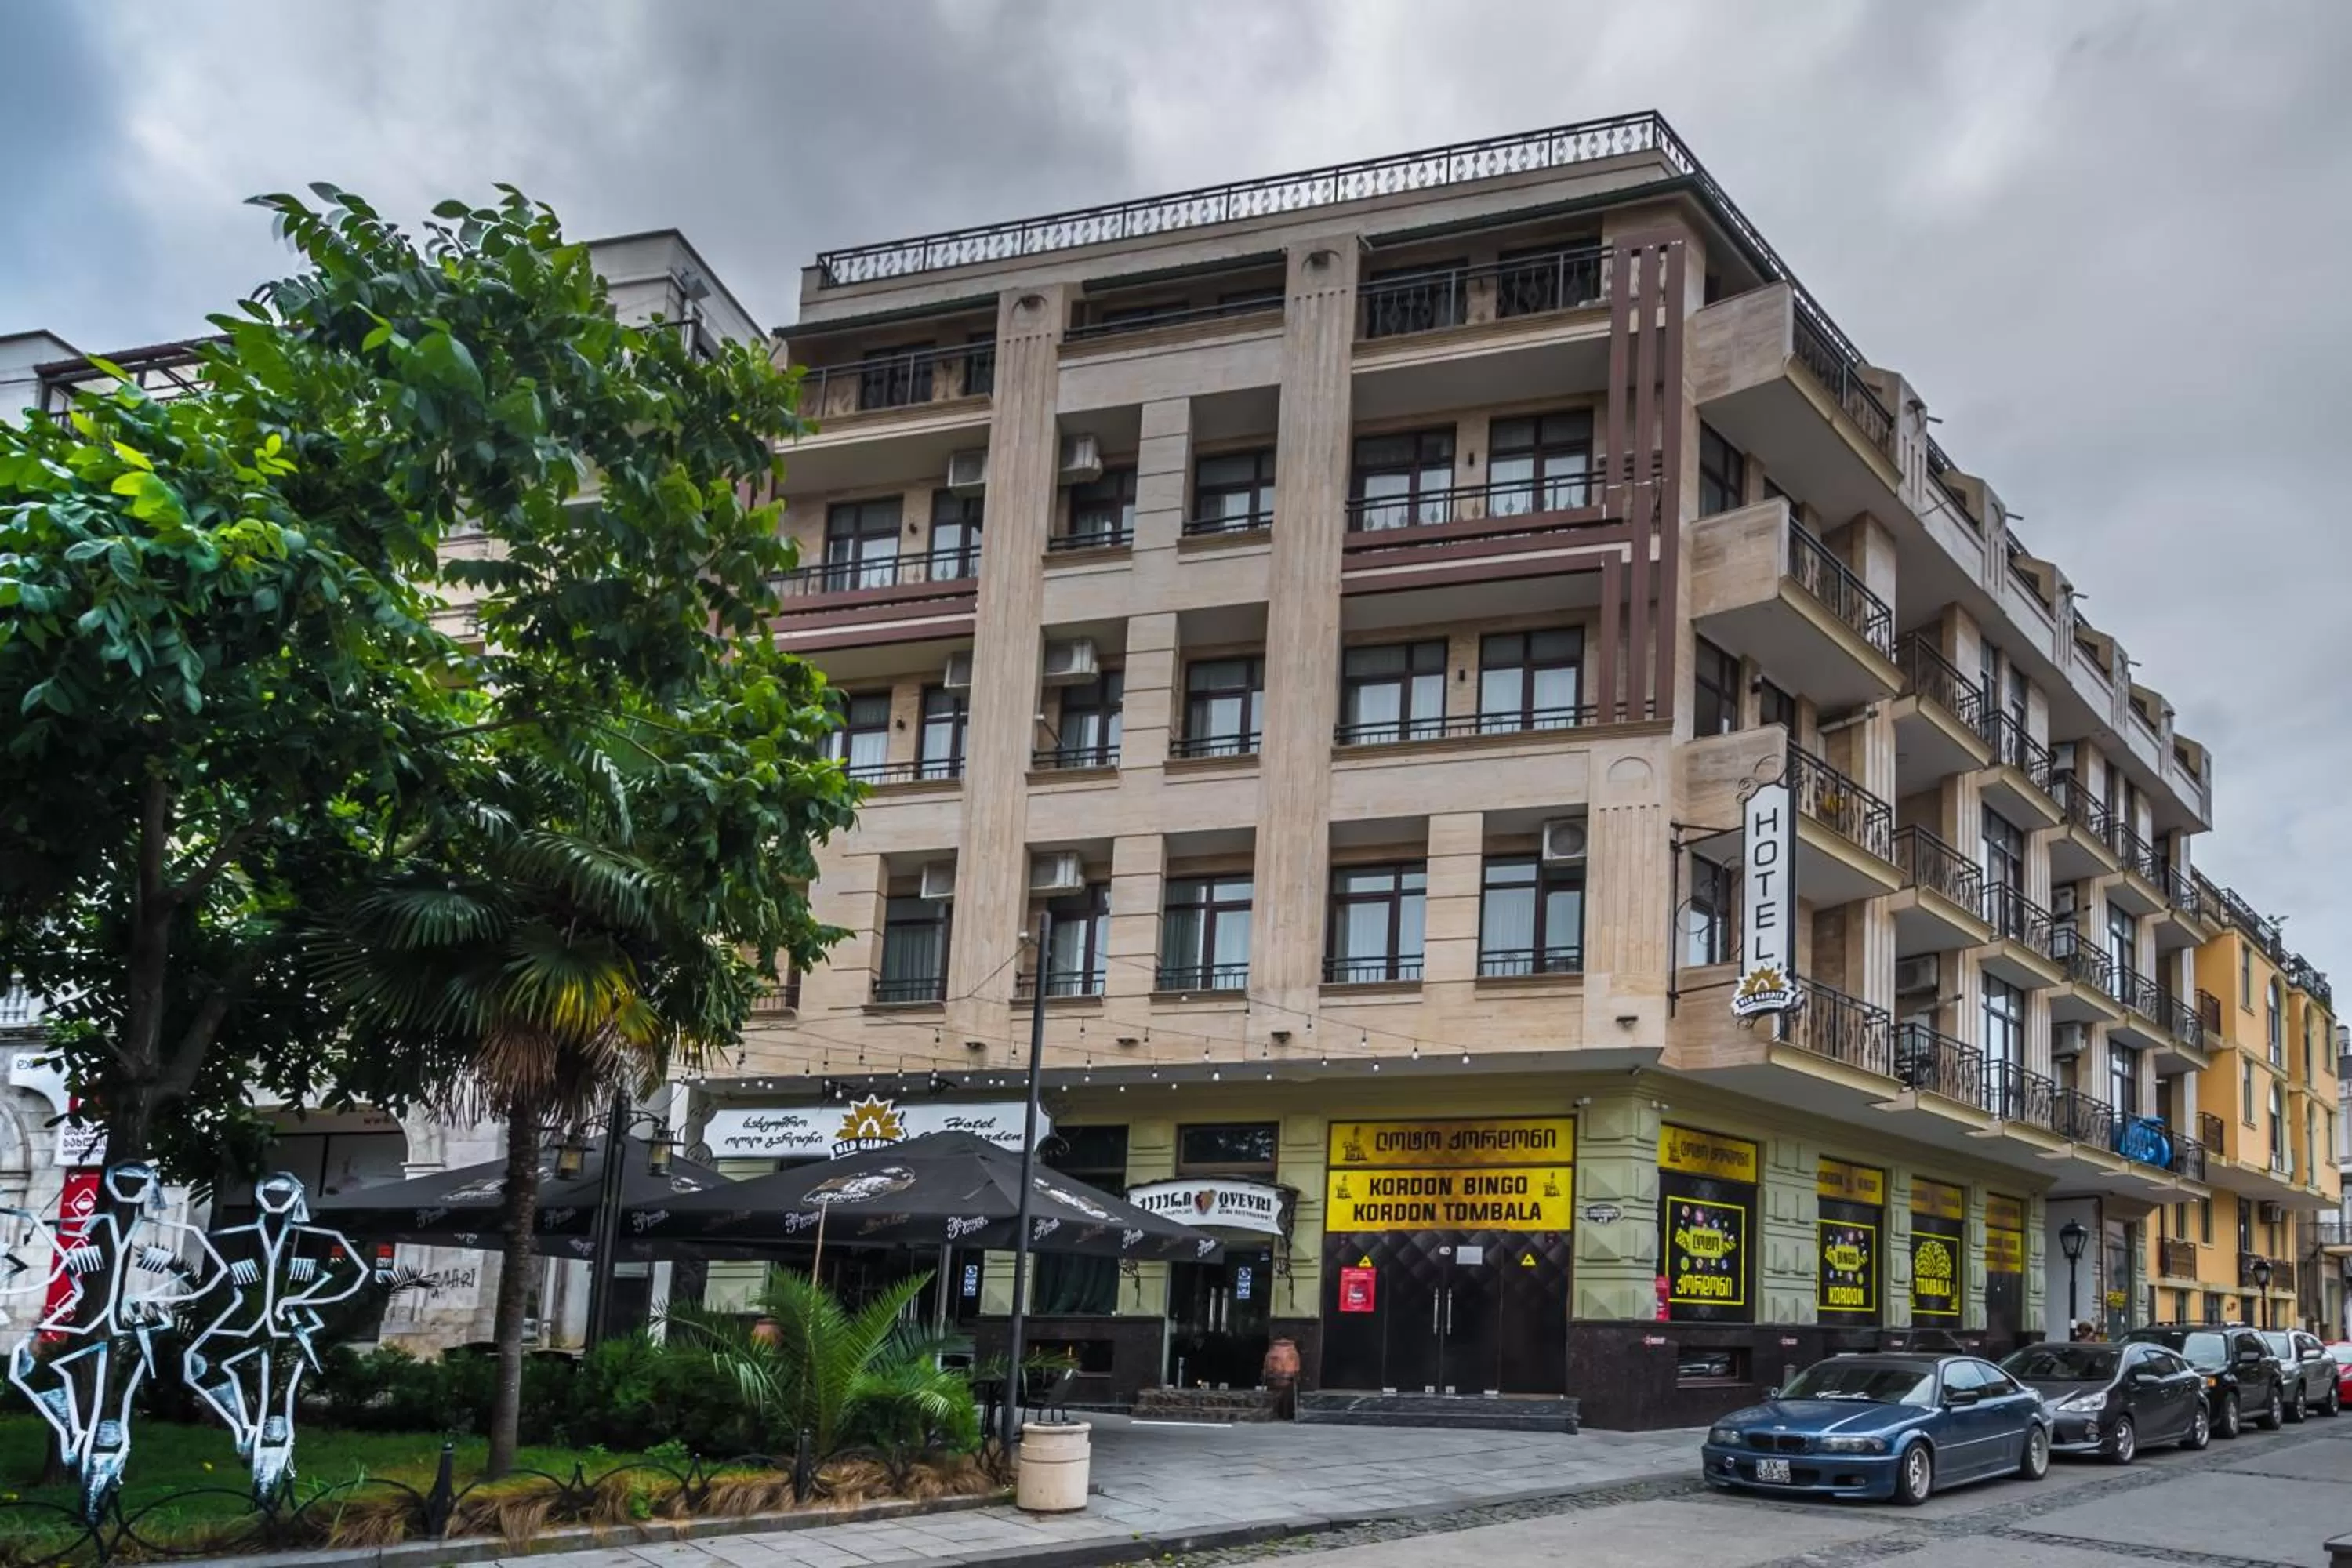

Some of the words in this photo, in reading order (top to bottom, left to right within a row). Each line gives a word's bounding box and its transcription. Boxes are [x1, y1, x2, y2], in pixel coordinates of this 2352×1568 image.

[1755, 808, 1777, 960] HOTEL
[943, 1116, 996, 1129] Hotel
[836, 1140, 856, 1154] OLD
[1375, 1131, 1442, 1152] ლოტო
[1449, 1127, 1556, 1151] ქორდონი
[1369, 1178, 1453, 1196] KORDON
[1464, 1176, 1528, 1196] BINGO
[1218, 1191, 1271, 1212] QVEVRI
[1353, 1203, 1436, 1222] KORDON
[1443, 1201, 1542, 1221] TOMBALA
[1828, 1287, 1864, 1305] KORDON
